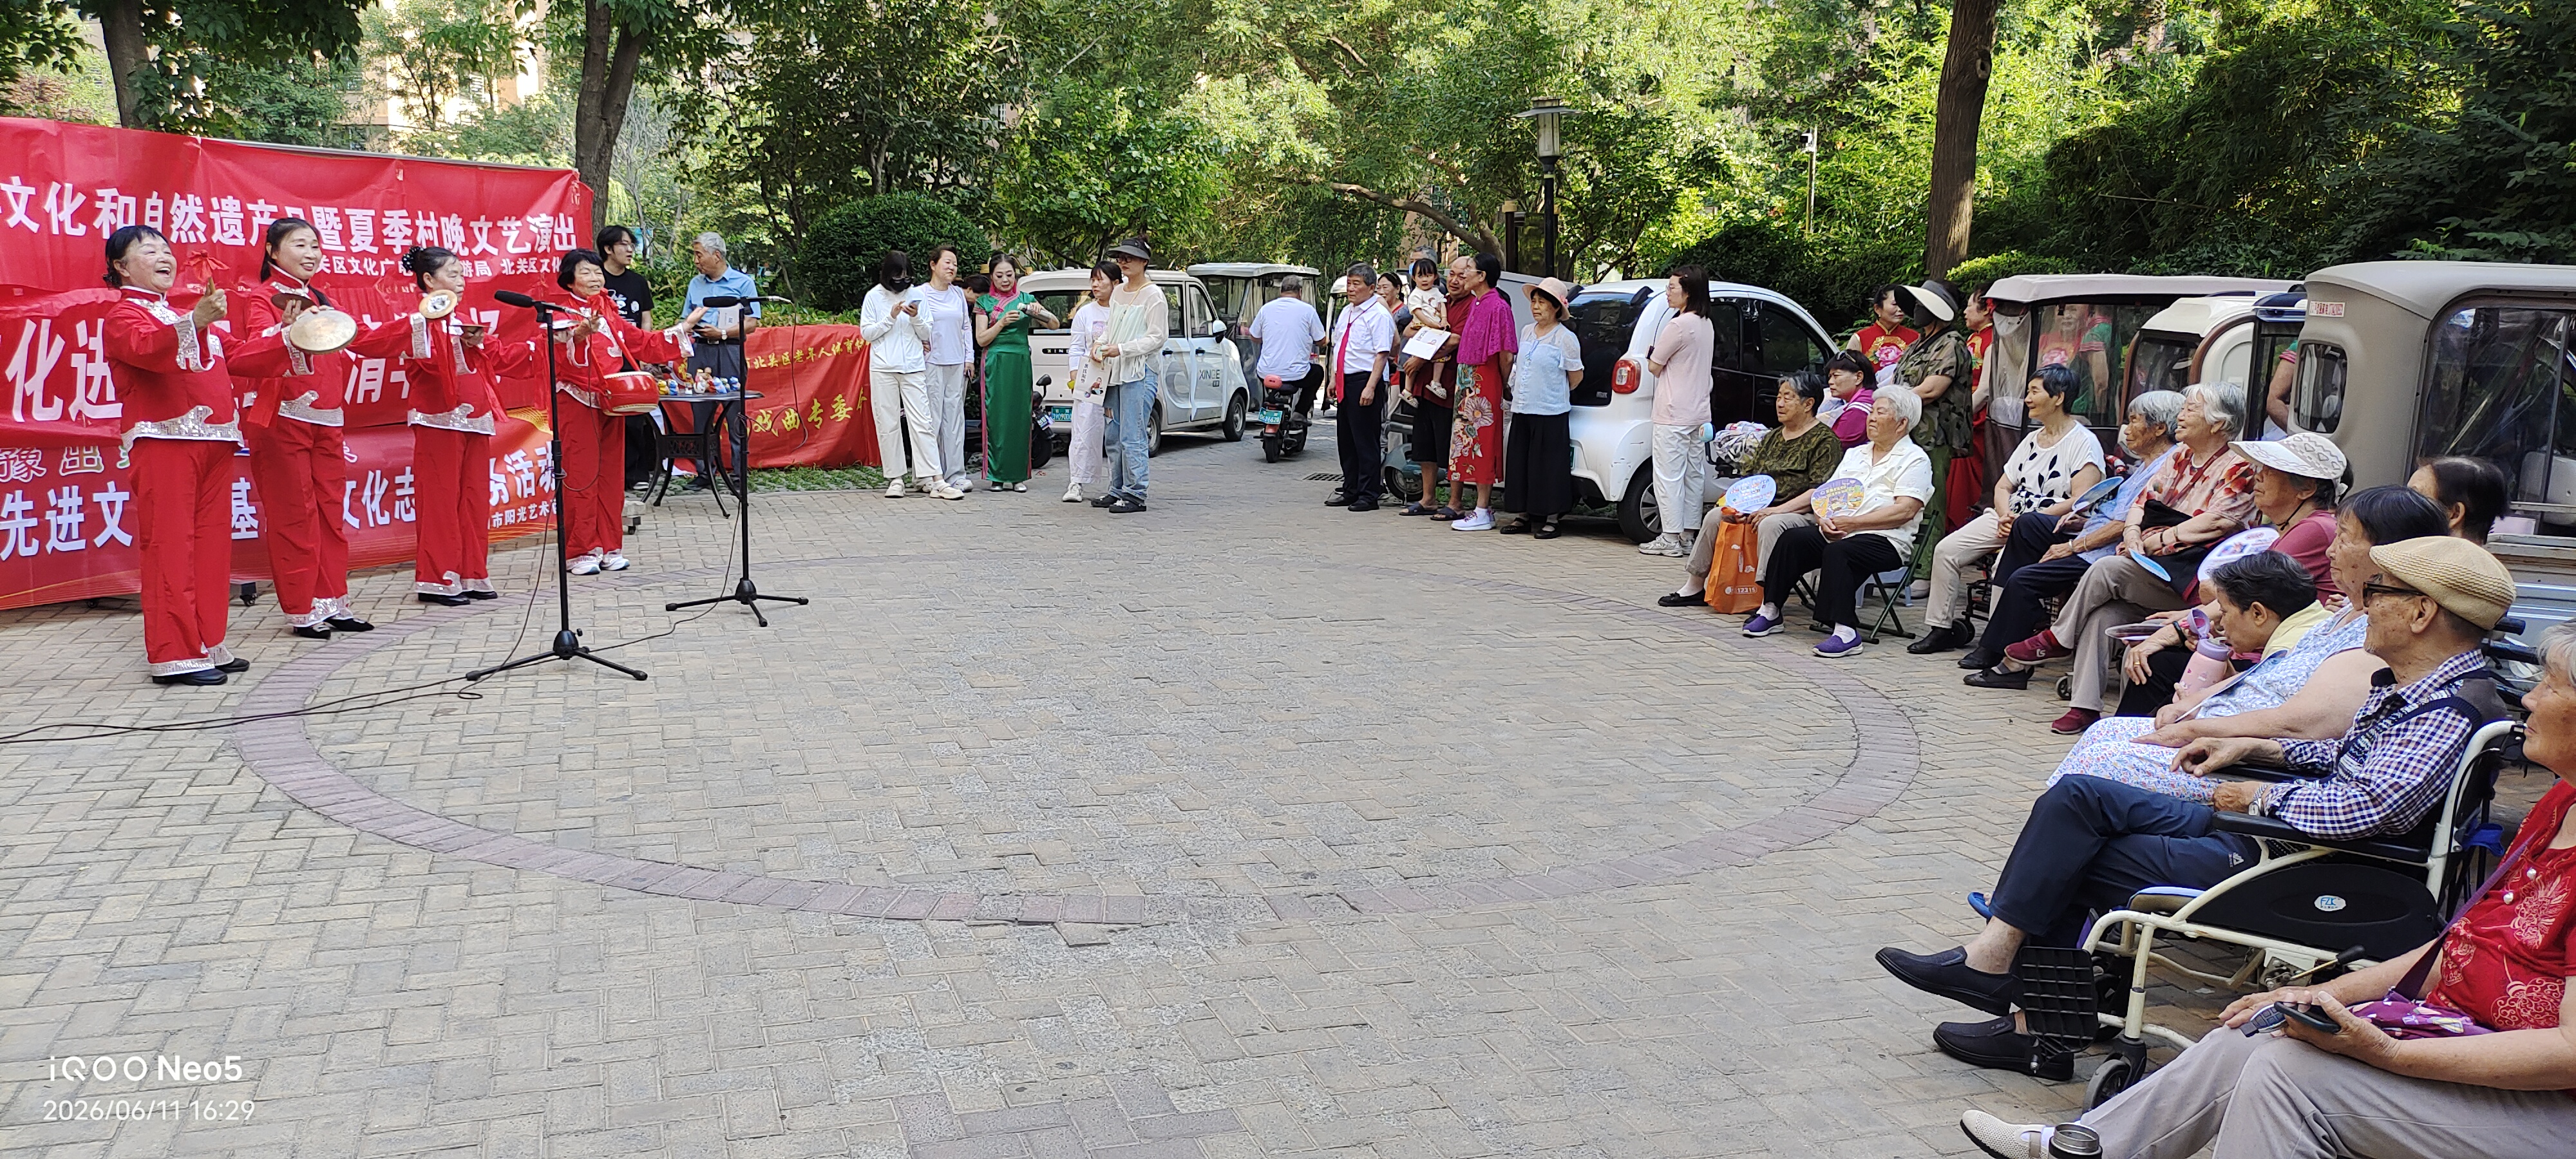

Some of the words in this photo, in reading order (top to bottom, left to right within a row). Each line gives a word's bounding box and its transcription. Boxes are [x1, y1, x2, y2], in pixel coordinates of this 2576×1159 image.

[746, 386, 867, 437] 戏曲专委
[0, 446, 131, 483] 豫出
[488, 499, 556, 530] 市阳光艺术
